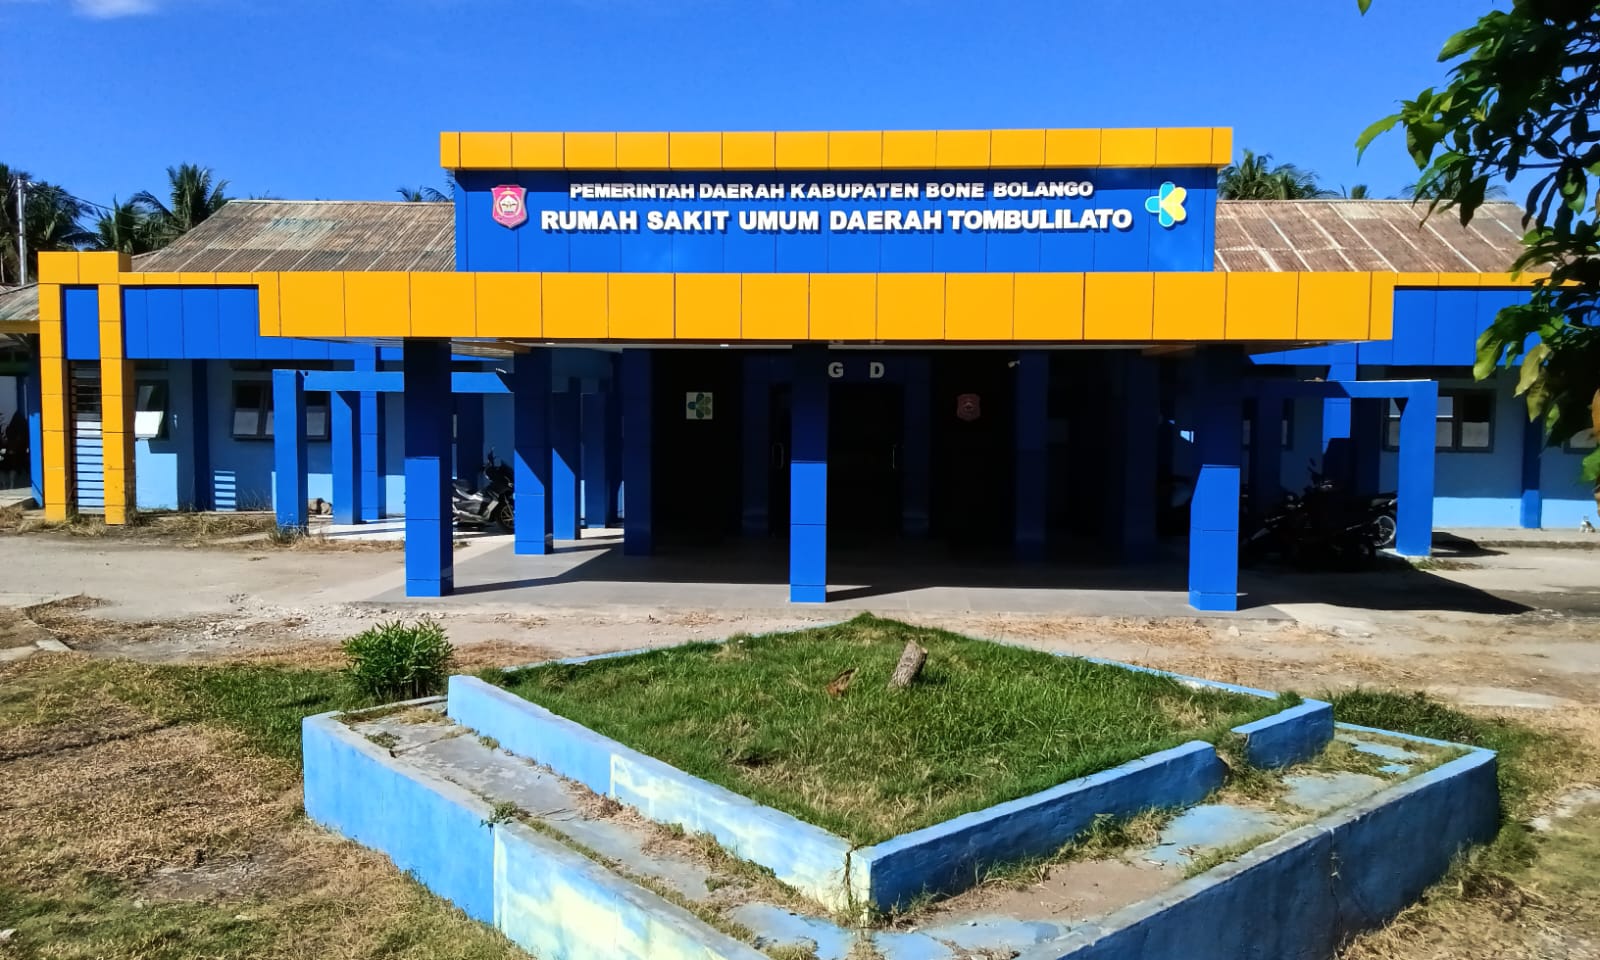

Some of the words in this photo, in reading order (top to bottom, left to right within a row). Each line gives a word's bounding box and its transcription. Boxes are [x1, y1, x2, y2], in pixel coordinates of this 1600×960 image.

[570, 183, 695, 199] PEMERINTAH
[700, 183, 785, 199] DAERAH
[790, 183, 919, 199] KABUPATEN
[926, 183, 985, 198] BONE
[992, 182, 1094, 197] BOLANGO
[541, 210, 638, 231] RUMAH
[646, 210, 730, 231] SAKIT
[738, 210, 820, 231] UMUM
[829, 210, 942, 231] DAERAH
[947, 208, 1133, 230] TOMBULILATO
